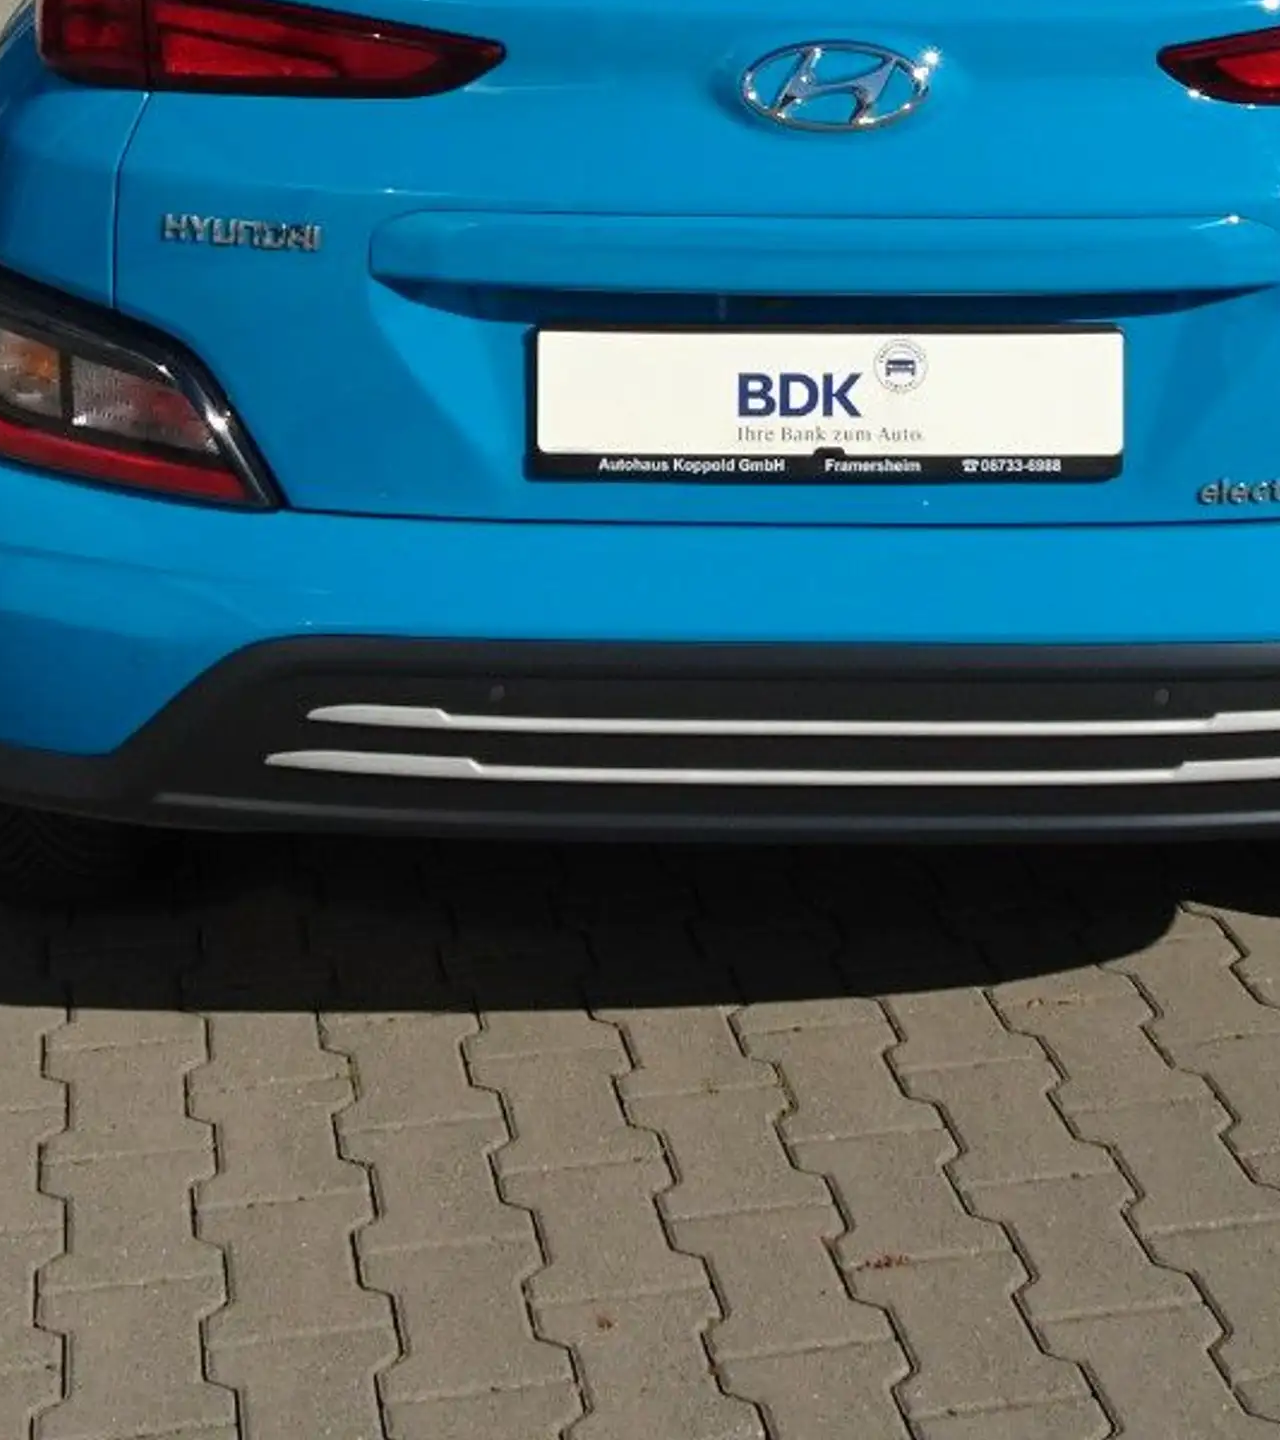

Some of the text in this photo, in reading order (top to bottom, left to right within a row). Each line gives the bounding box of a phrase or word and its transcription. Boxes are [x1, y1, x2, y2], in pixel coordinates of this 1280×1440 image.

[738, 372, 863, 417] BDK
[737, 426, 775, 442] Ihre
[781, 426, 826, 442] Bank
[834, 430, 871, 442] zum
[598, 458, 785, 474] Autohaus Koppold GmbH
[824, 458, 921, 472] Framersheim
